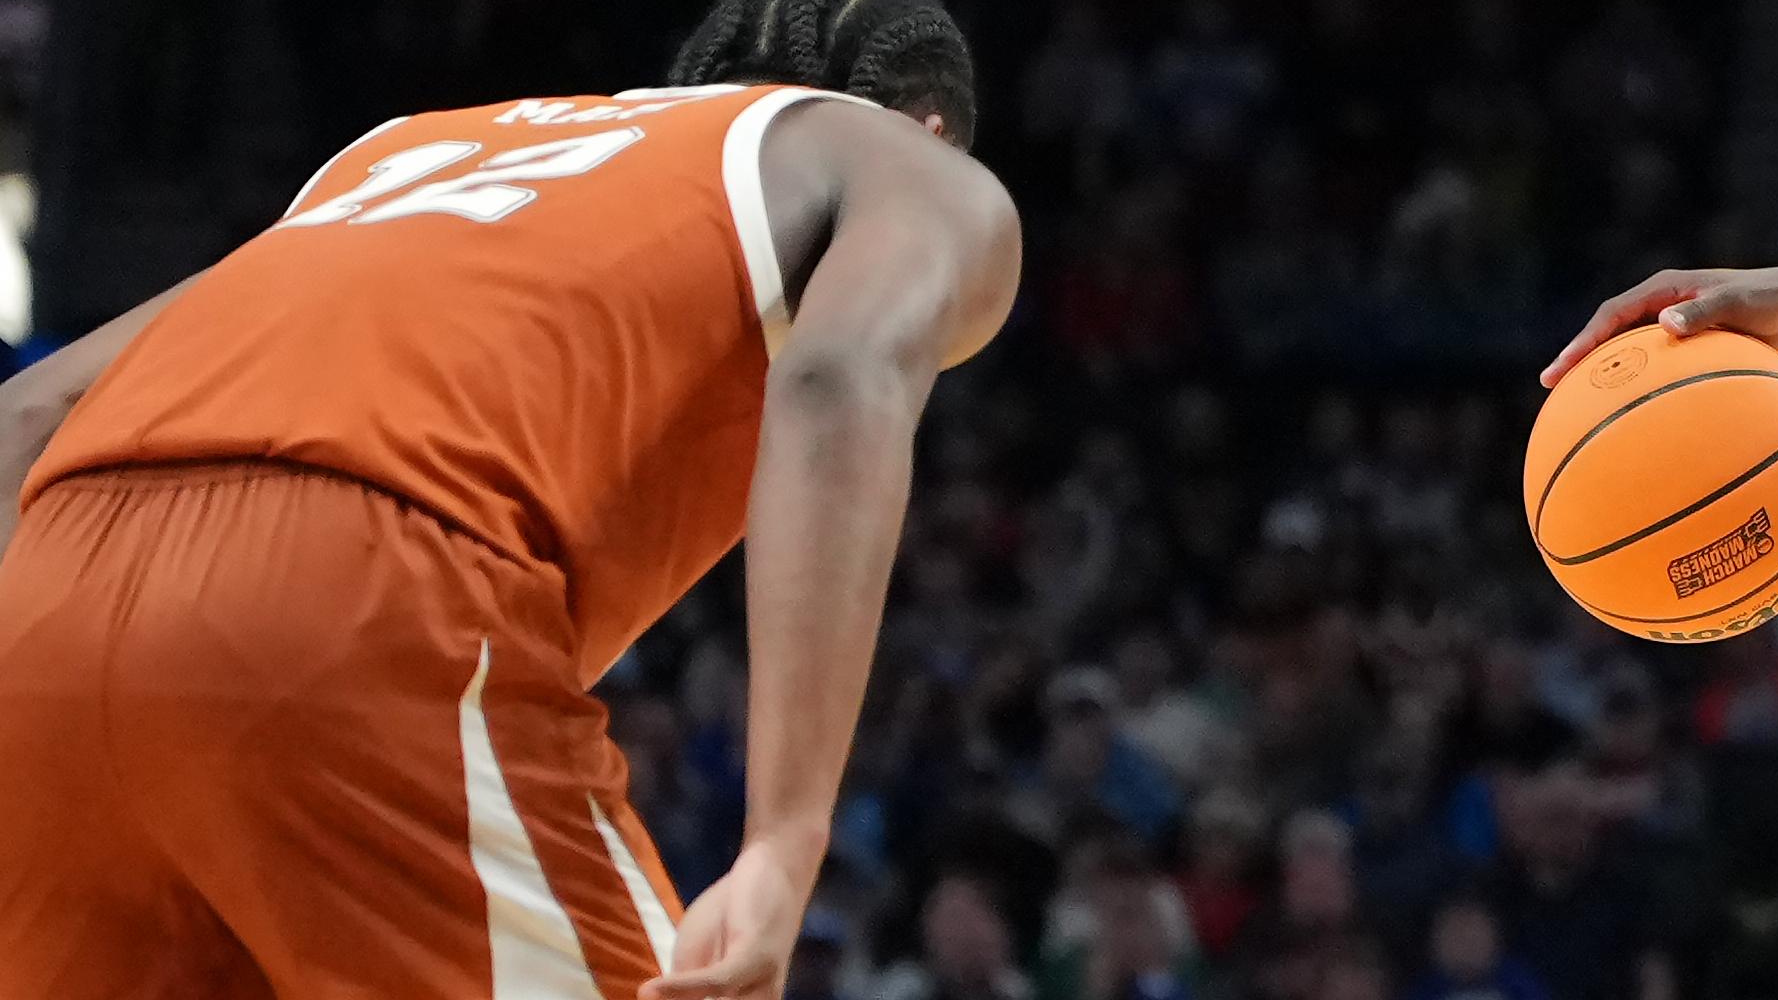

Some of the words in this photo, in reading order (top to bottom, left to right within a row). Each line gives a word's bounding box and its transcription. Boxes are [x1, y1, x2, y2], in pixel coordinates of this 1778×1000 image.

[268, 126, 646, 230] 12
[1668, 535, 1746, 583] MADNESS
[1702, 544, 1759, 586] MARCH
